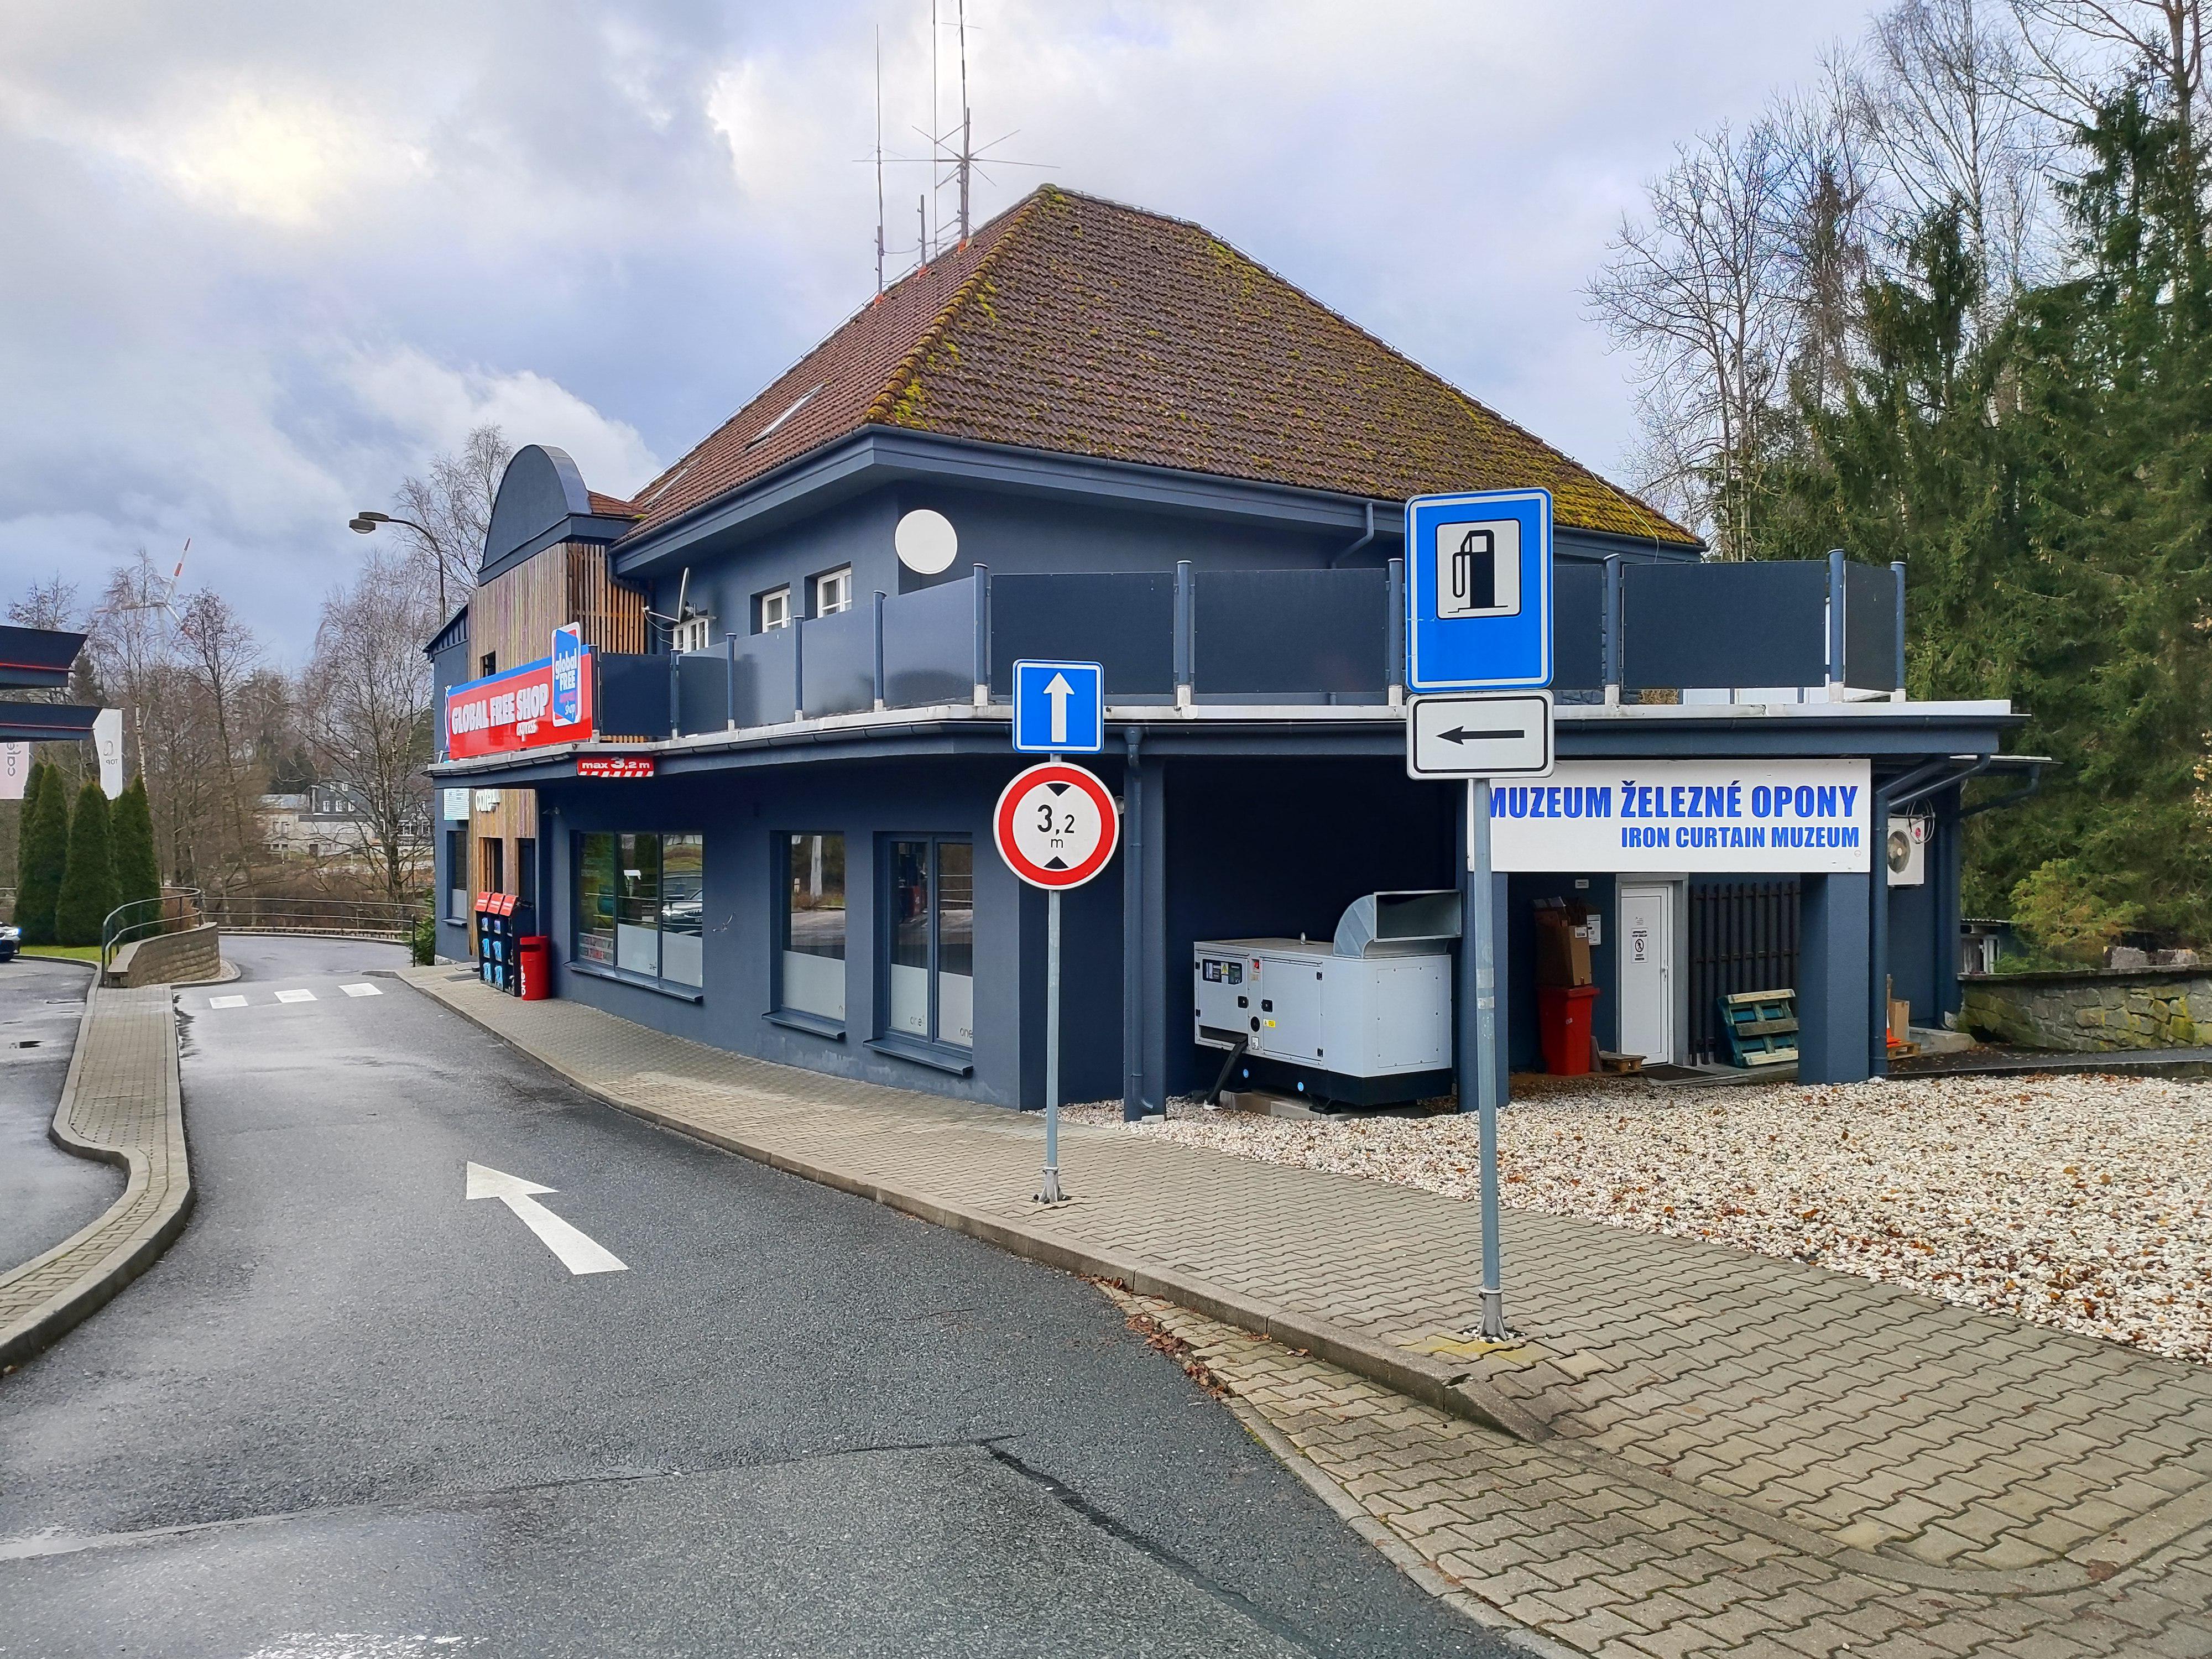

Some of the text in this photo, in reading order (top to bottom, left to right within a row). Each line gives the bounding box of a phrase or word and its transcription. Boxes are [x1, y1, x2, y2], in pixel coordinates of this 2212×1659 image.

[555, 648, 577, 680] global
[560, 670, 576, 691] FREE
[452, 684, 549, 734] GLOBAL FREE SHOP
[611, 757, 637, 770] 3,2
[1490, 780, 1859, 818] MUZEUM ŽELEZNÉ OPONY
[1037, 805, 1074, 836] 3,2
[1050, 838, 1063, 848] m
[1621, 827, 1859, 847] IRON CURTAIN MUZEUM
